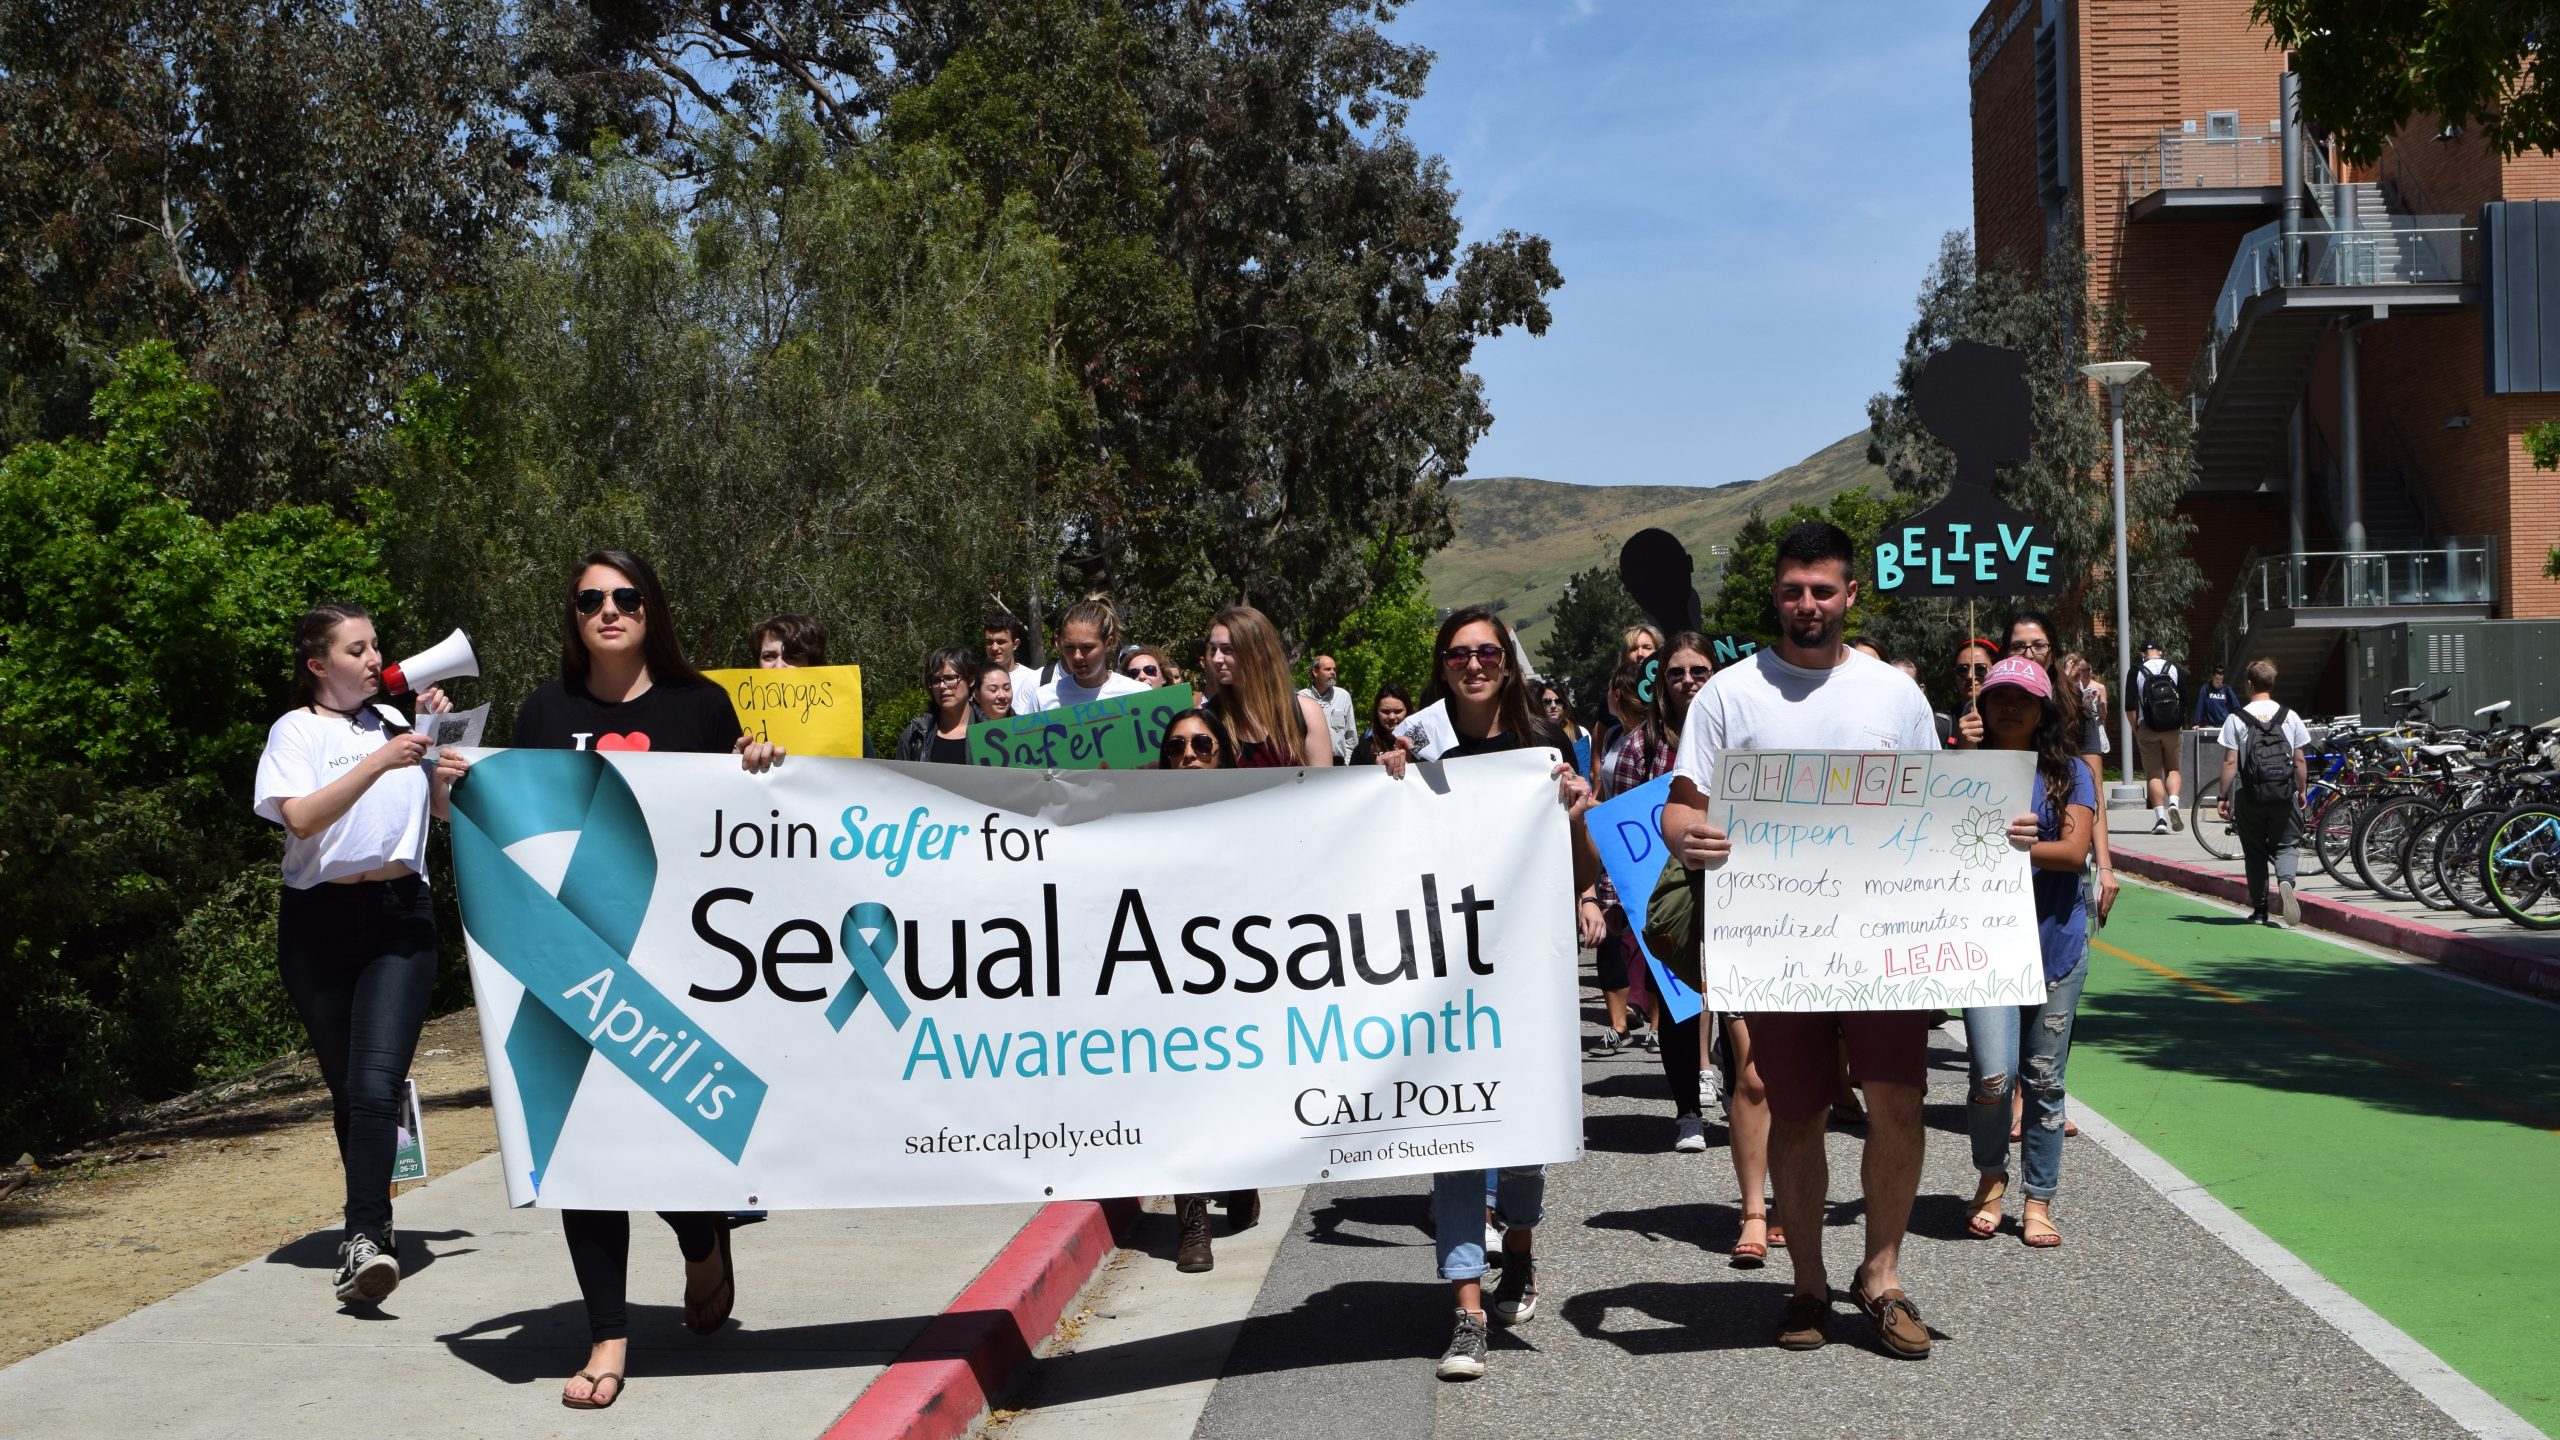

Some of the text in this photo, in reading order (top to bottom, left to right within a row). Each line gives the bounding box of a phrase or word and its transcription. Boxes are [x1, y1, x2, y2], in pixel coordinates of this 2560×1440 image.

[1876, 523, 2054, 590] BELIEVE
[738, 676, 834, 723] changes
[1012, 697, 1130, 732] CAL POLY
[980, 705, 1176, 768] Safer is
[328, 756, 349, 768] NO
[1727, 761, 2008, 805] CHANGE can
[700, 804, 1050, 878] Join Safer for
[1725, 804, 1854, 861] happen
[1716, 866, 2029, 909] grassroots movements and
[1095, 873, 1495, 996] Assault
[1860, 908, 1969, 939] communities
[1983, 913, 2019, 928] are
[1780, 941, 1989, 981] in the LEAD
[562, 967, 737, 1121] April is
[902, 988, 1502, 1080] Awareness Month
[1294, 1081, 1501, 1126] CAL POLY
[904, 1120, 1143, 1160] safer.calpoly.edu
[1329, 1137, 1475, 1165] Dean of Students
